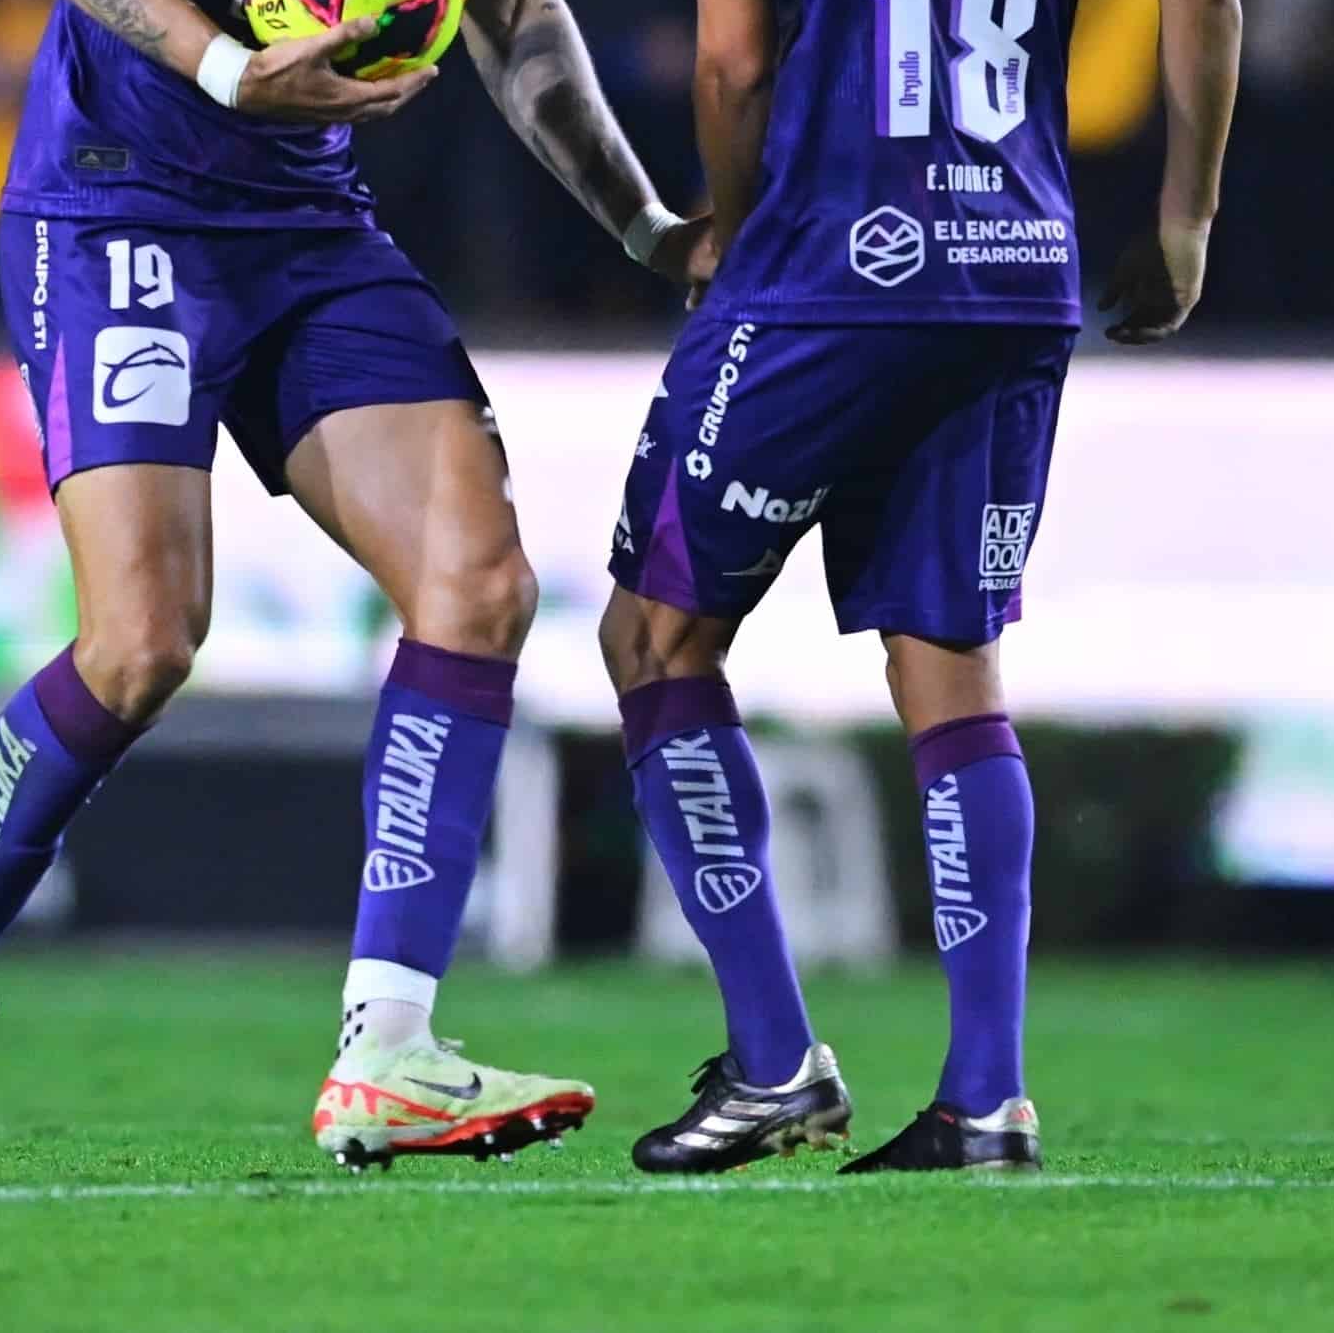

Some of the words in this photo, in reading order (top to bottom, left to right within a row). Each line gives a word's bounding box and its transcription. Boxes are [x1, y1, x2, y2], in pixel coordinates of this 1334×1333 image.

[899, 51, 923, 107] Orgullo
[33, 220, 50, 307] GRUPO
[934, 220, 964, 241] EL
[966, 219, 1066, 241] ENCANTO
[947, 247, 1069, 264] DESARROLLOS
[105, 239, 175, 310] 19
[698, 362, 739, 447] GRUPO
[376, 713, 450, 855] ITALIKA
[660, 729, 744, 858] ITALIK
[926, 773, 973, 904] ITALIK
